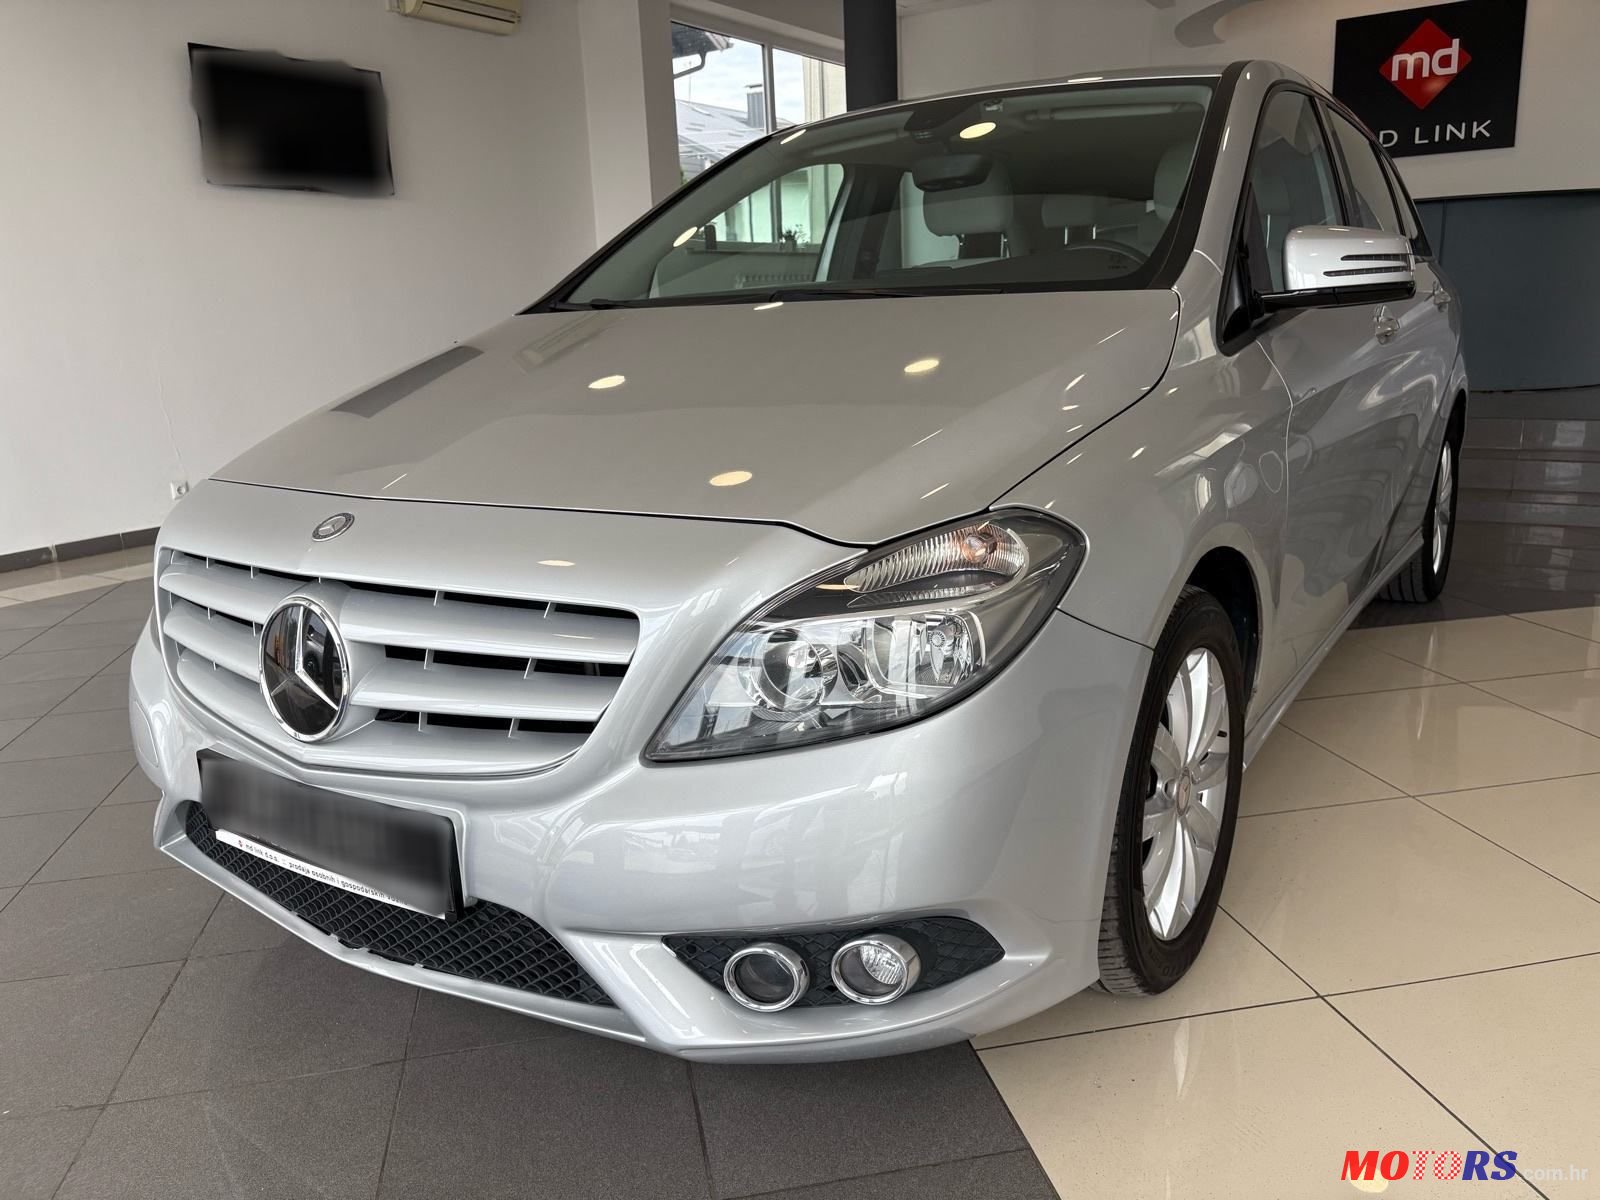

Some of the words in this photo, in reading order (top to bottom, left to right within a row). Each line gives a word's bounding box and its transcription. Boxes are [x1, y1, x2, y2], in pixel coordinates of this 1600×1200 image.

[1391, 38, 1460, 82] md
[1414, 119, 1492, 145] LINK
[289, 862, 311, 875] prodaja
[311, 870, 336, 885] osobnih
